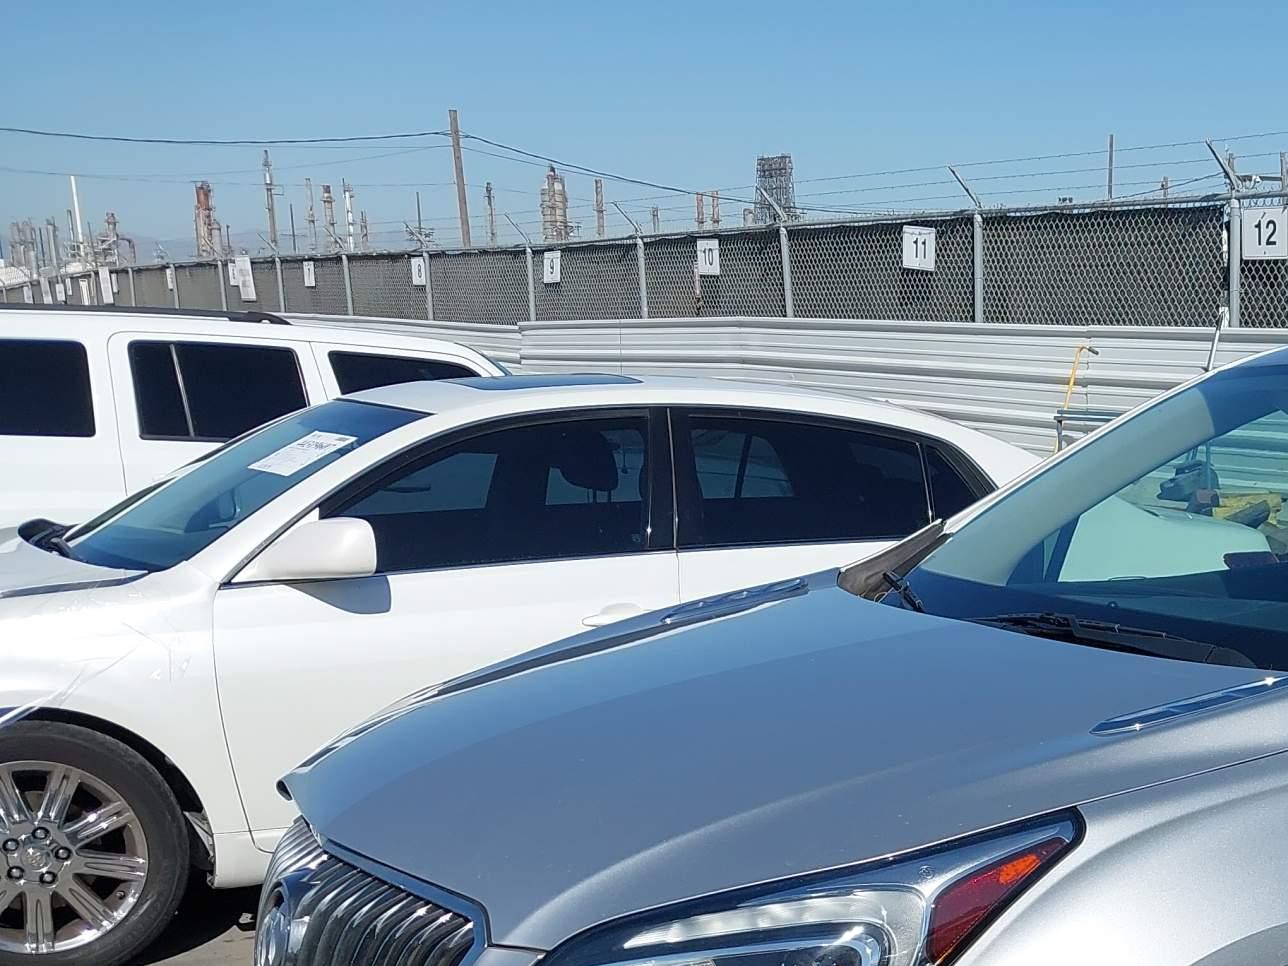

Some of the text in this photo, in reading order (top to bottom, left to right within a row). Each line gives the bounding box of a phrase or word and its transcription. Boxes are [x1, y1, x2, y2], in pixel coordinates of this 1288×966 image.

[1254, 219, 1277, 247] 12
[702, 247, 714, 266] 10
[912, 237, 927, 260] 11
